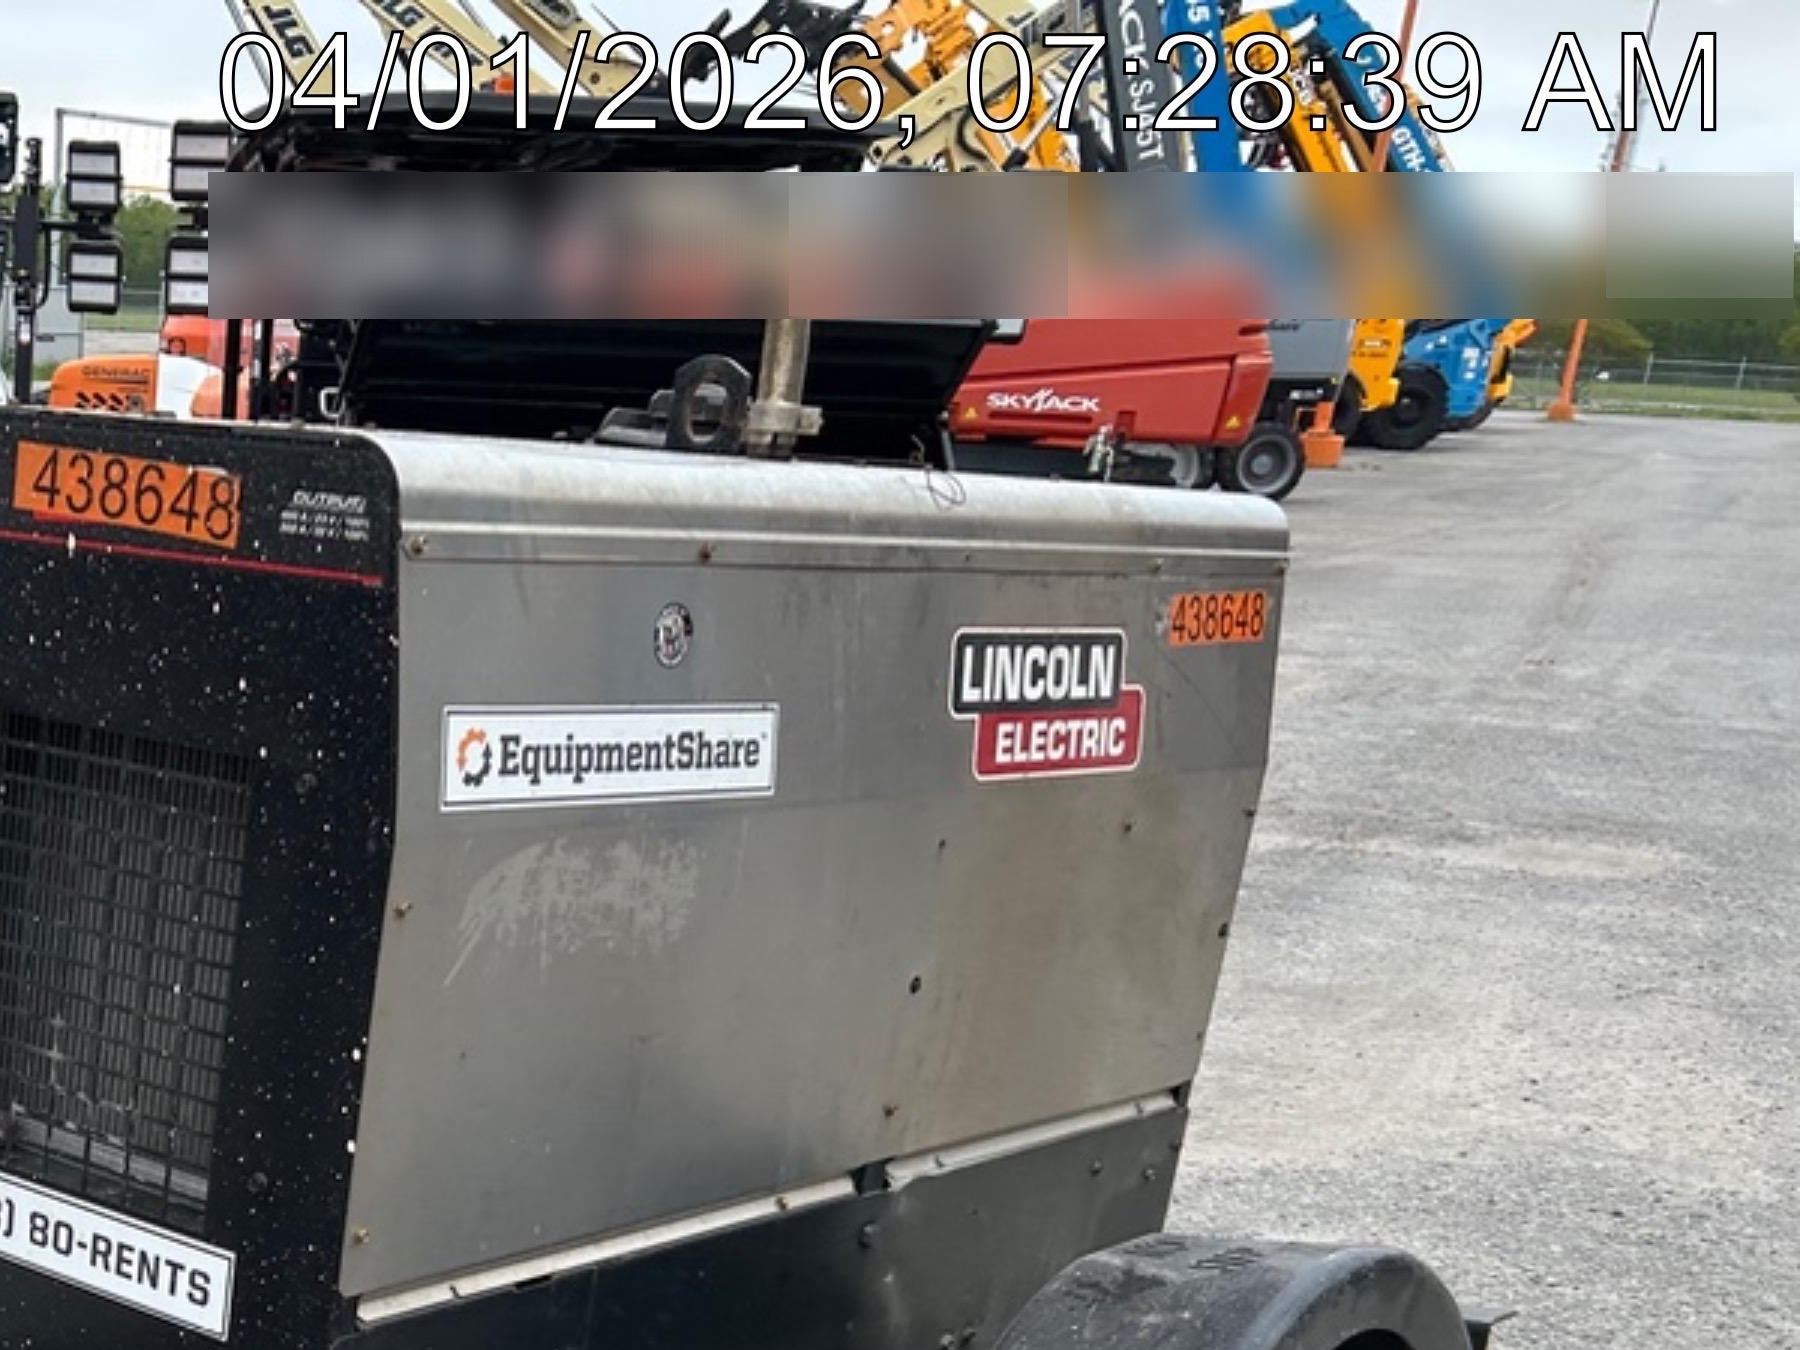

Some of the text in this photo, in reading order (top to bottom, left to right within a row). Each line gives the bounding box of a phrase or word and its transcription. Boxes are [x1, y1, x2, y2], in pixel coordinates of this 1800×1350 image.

[262, 5, 315, 58] JLG
[81, 366, 150, 377] GENERAC
[986, 387, 1100, 413] SKYJACK
[32, 448, 239, 540] 438648
[1170, 592, 1265, 642] 438648
[961, 643, 1117, 702] LINCOLN
[497, 730, 761, 786] EquipmentShare
[994, 716, 1127, 764] ELECTRIC
[29, 1210, 212, 1307] 80-RENTS
